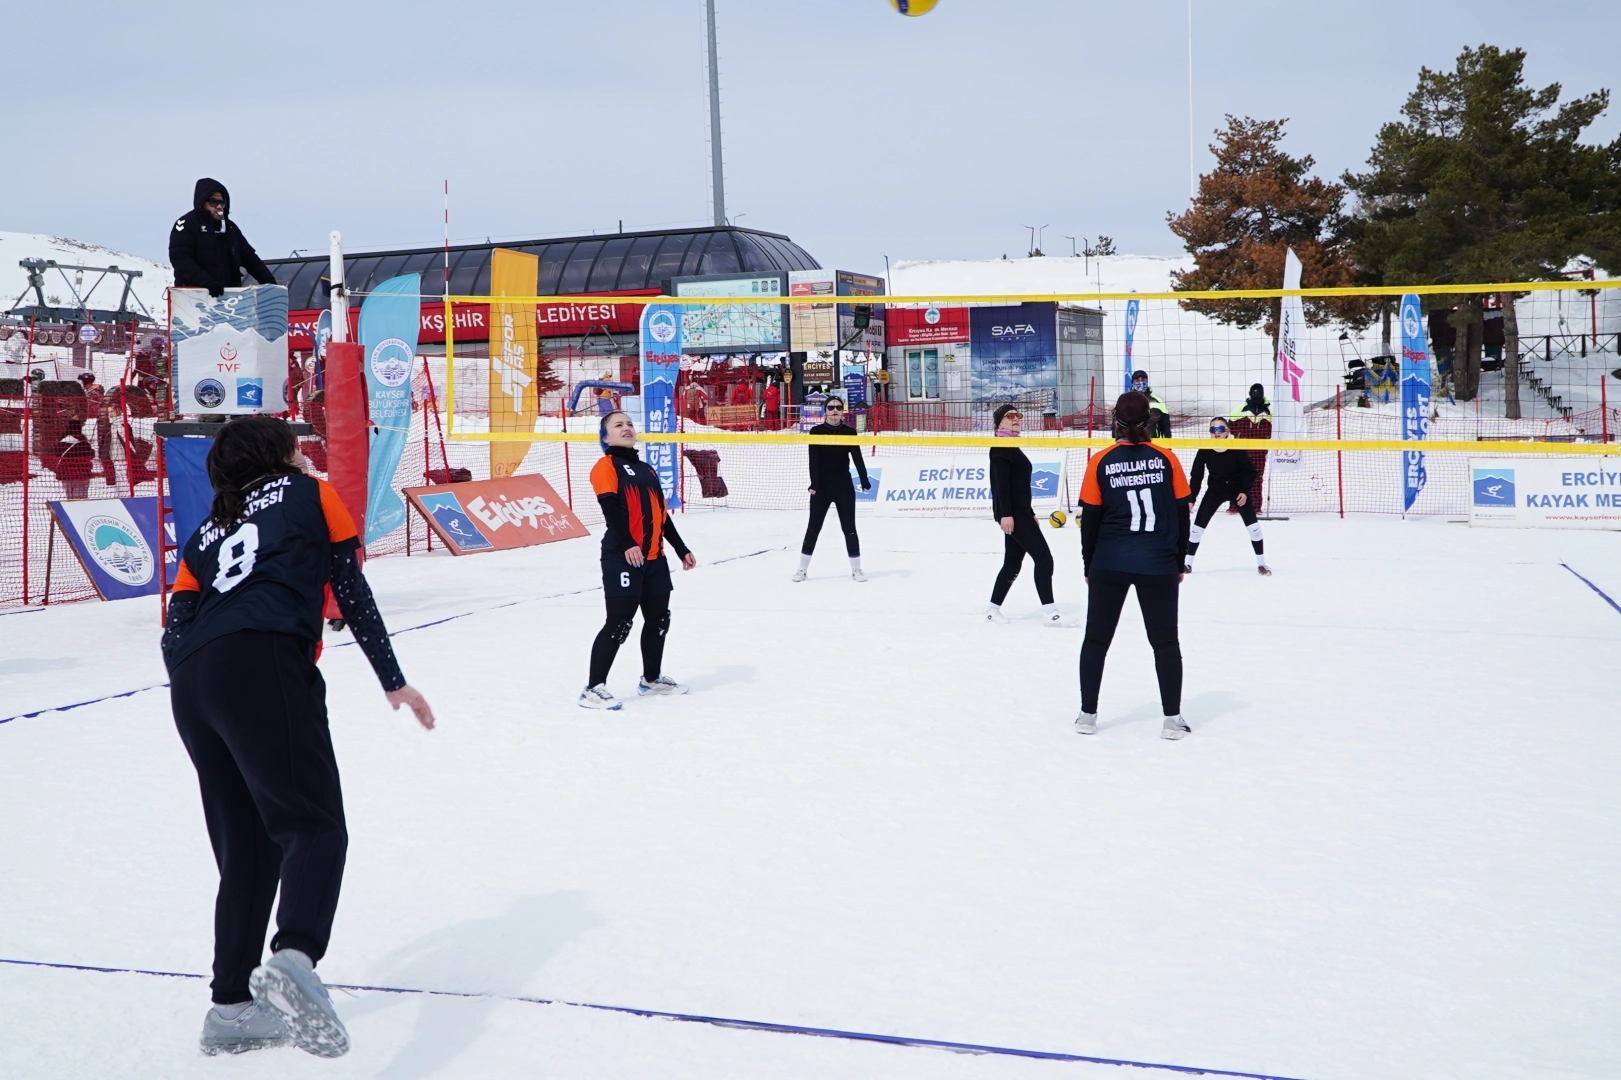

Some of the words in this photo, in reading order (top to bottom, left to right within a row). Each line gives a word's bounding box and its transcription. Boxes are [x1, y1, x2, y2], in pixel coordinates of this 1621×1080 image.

[991, 324, 1036, 336] SAFA
[1282, 310, 1290, 356] SPOR
[503, 314, 514, 365] SPOR
[216, 363, 241, 373] TVF
[646, 350, 679, 368] Erciyes
[659, 396, 673, 467] REORT
[1406, 407, 1420, 488] ERCYES
[623, 464, 636, 476] 6
[918, 464, 986, 482] ERCİYES
[1105, 459, 1147, 476] ABDULLAH
[1147, 456, 1166, 470] GÜL
[1109, 470, 1164, 489] ÜNİVERSİTESİ
[1561, 468, 1621, 486] ERCİY
[885, 487, 939, 502] KAYAK
[942, 487, 993, 500] MERK
[1526, 494, 1590, 508] KAYAK
[466, 494, 555, 532] Erciyes
[1126, 488, 1156, 532] 11
[211, 522, 260, 594] 8
[620, 571, 630, 588] 6
